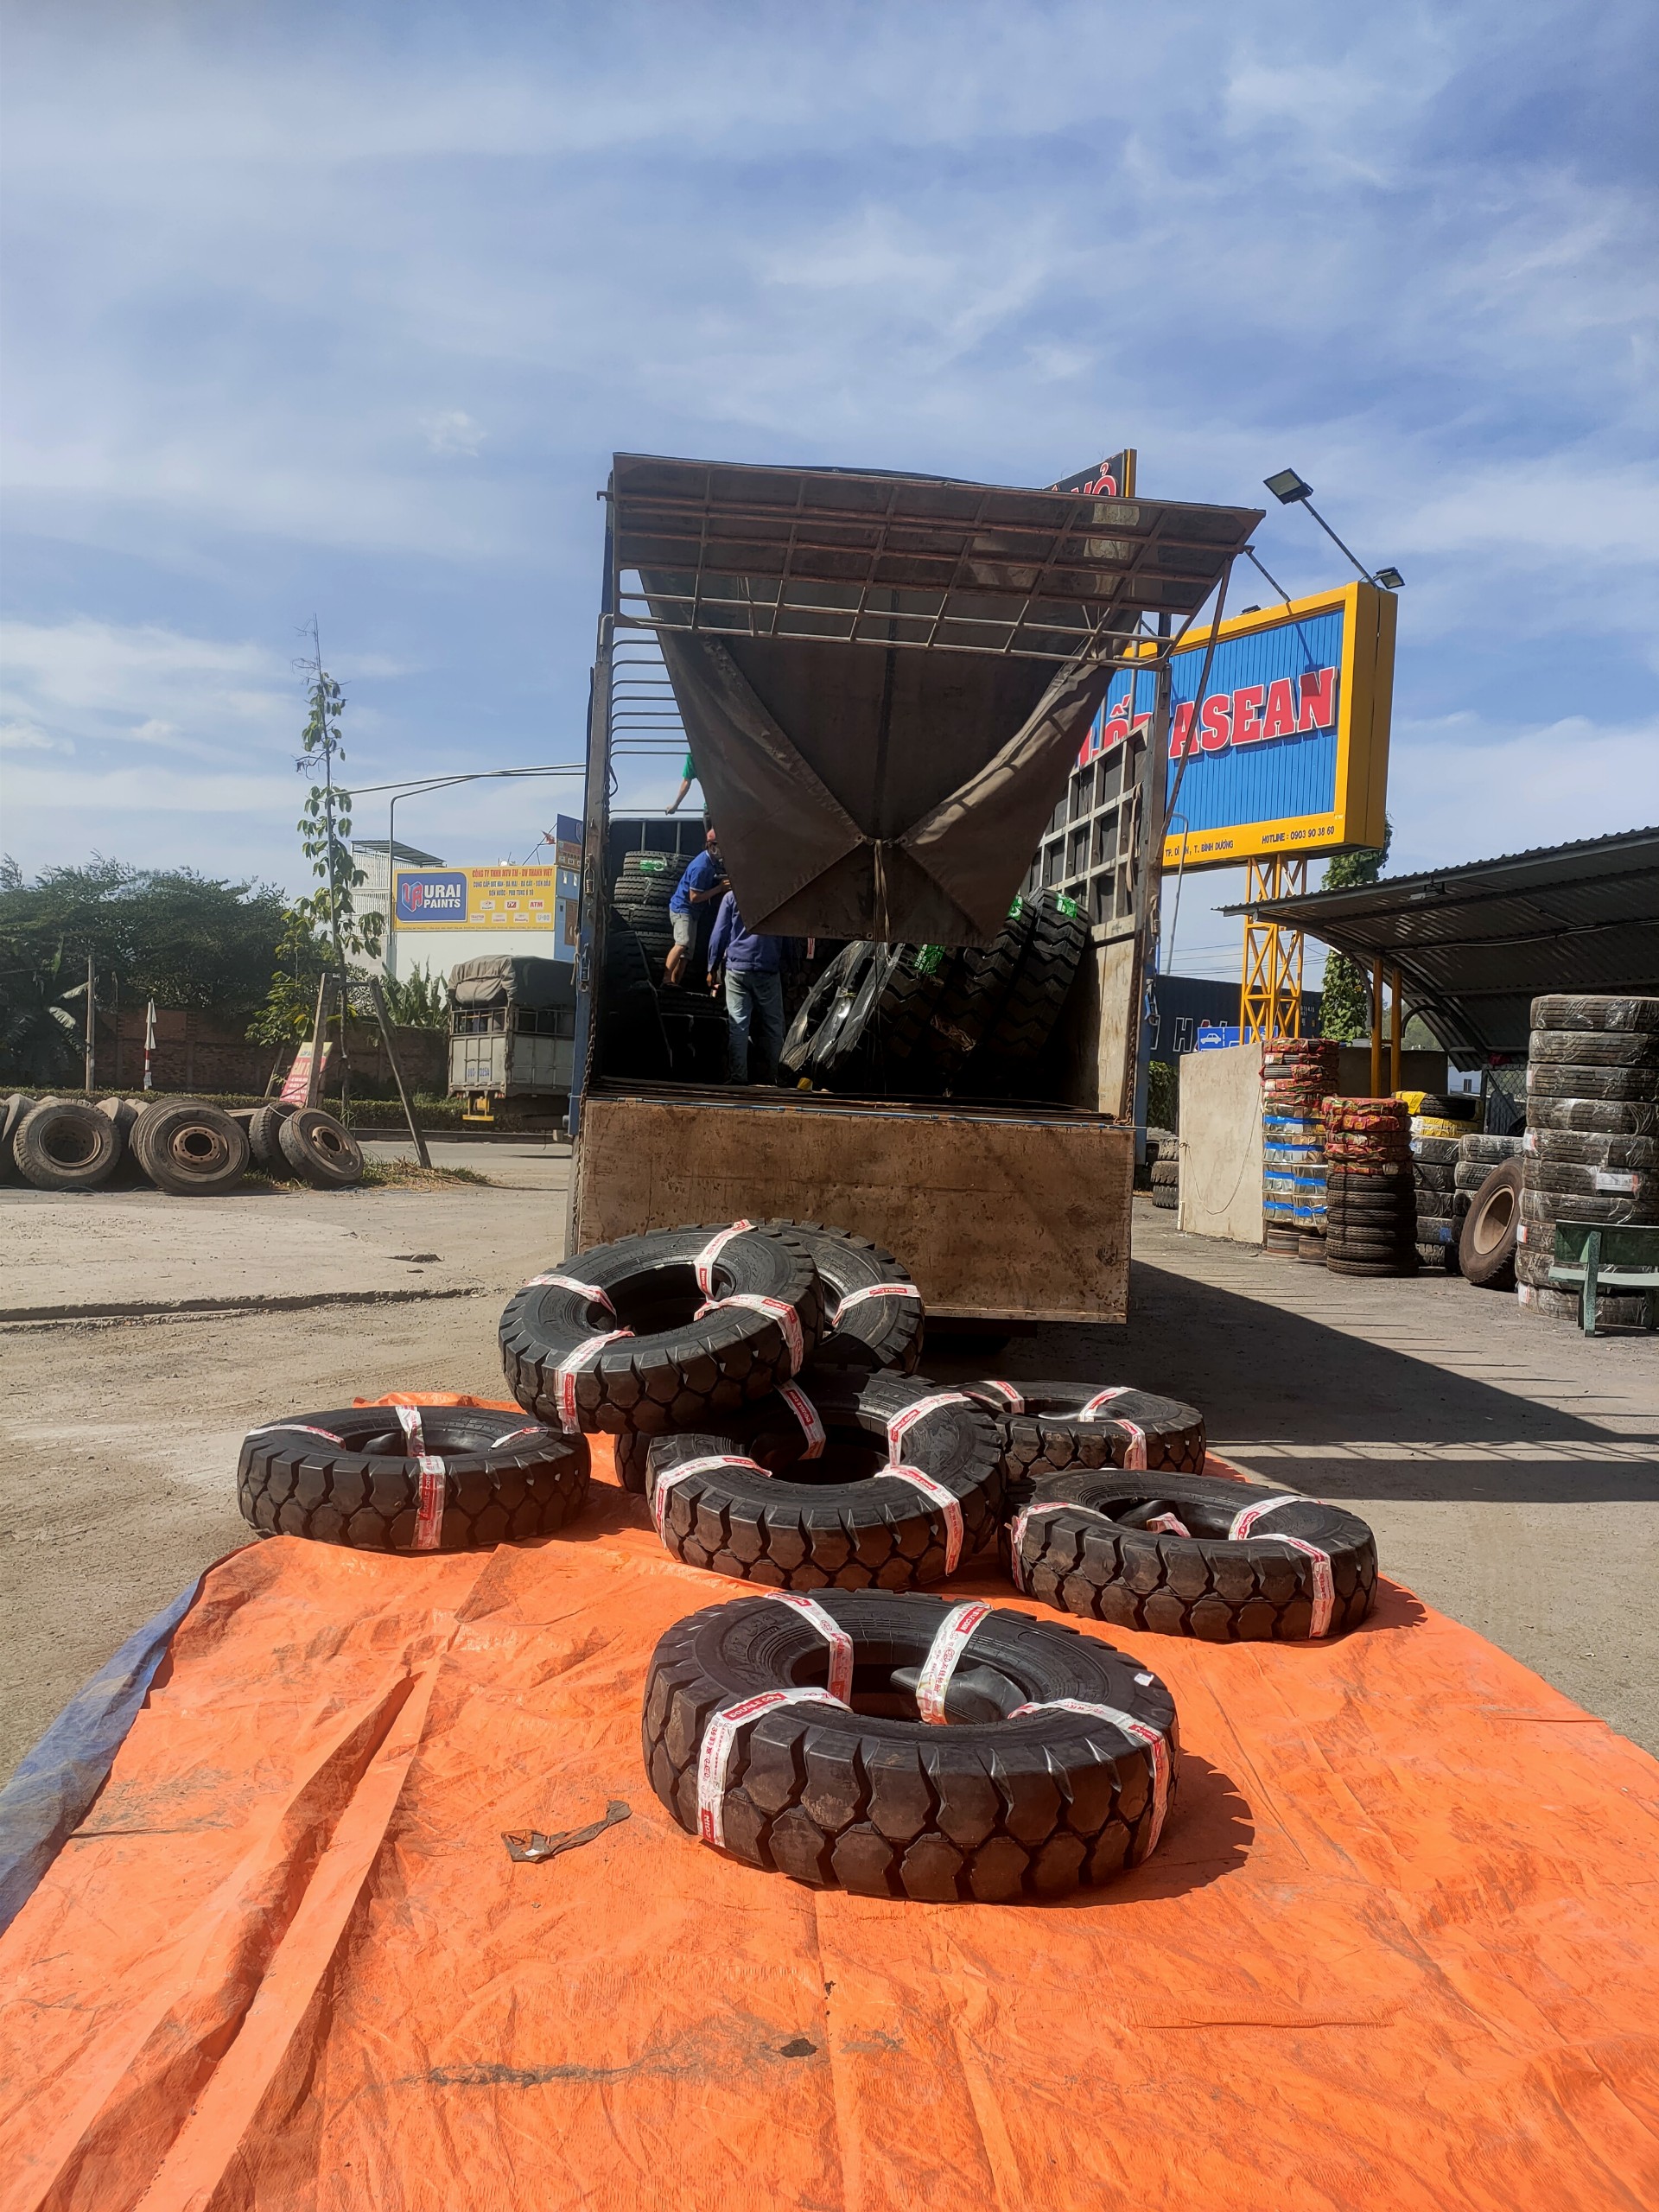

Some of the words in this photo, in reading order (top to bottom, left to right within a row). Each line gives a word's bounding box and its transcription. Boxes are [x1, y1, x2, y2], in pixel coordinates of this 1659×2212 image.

[1168, 665, 1339, 760] ASEAN
[1262, 833, 1285, 844] HOTLINE
[1290, 830, 1306, 840] 0903
[1326, 825, 1335, 836] 60
[424, 884, 461, 899] URAI
[423, 899, 461, 908] PAINTS
[797, 1402, 811, 1423] DOUBLE
[423, 1491, 431, 1519] DOUBLE
[728, 1700, 762, 1719] DOUBLE
[703, 1815, 712, 1839] COIN
